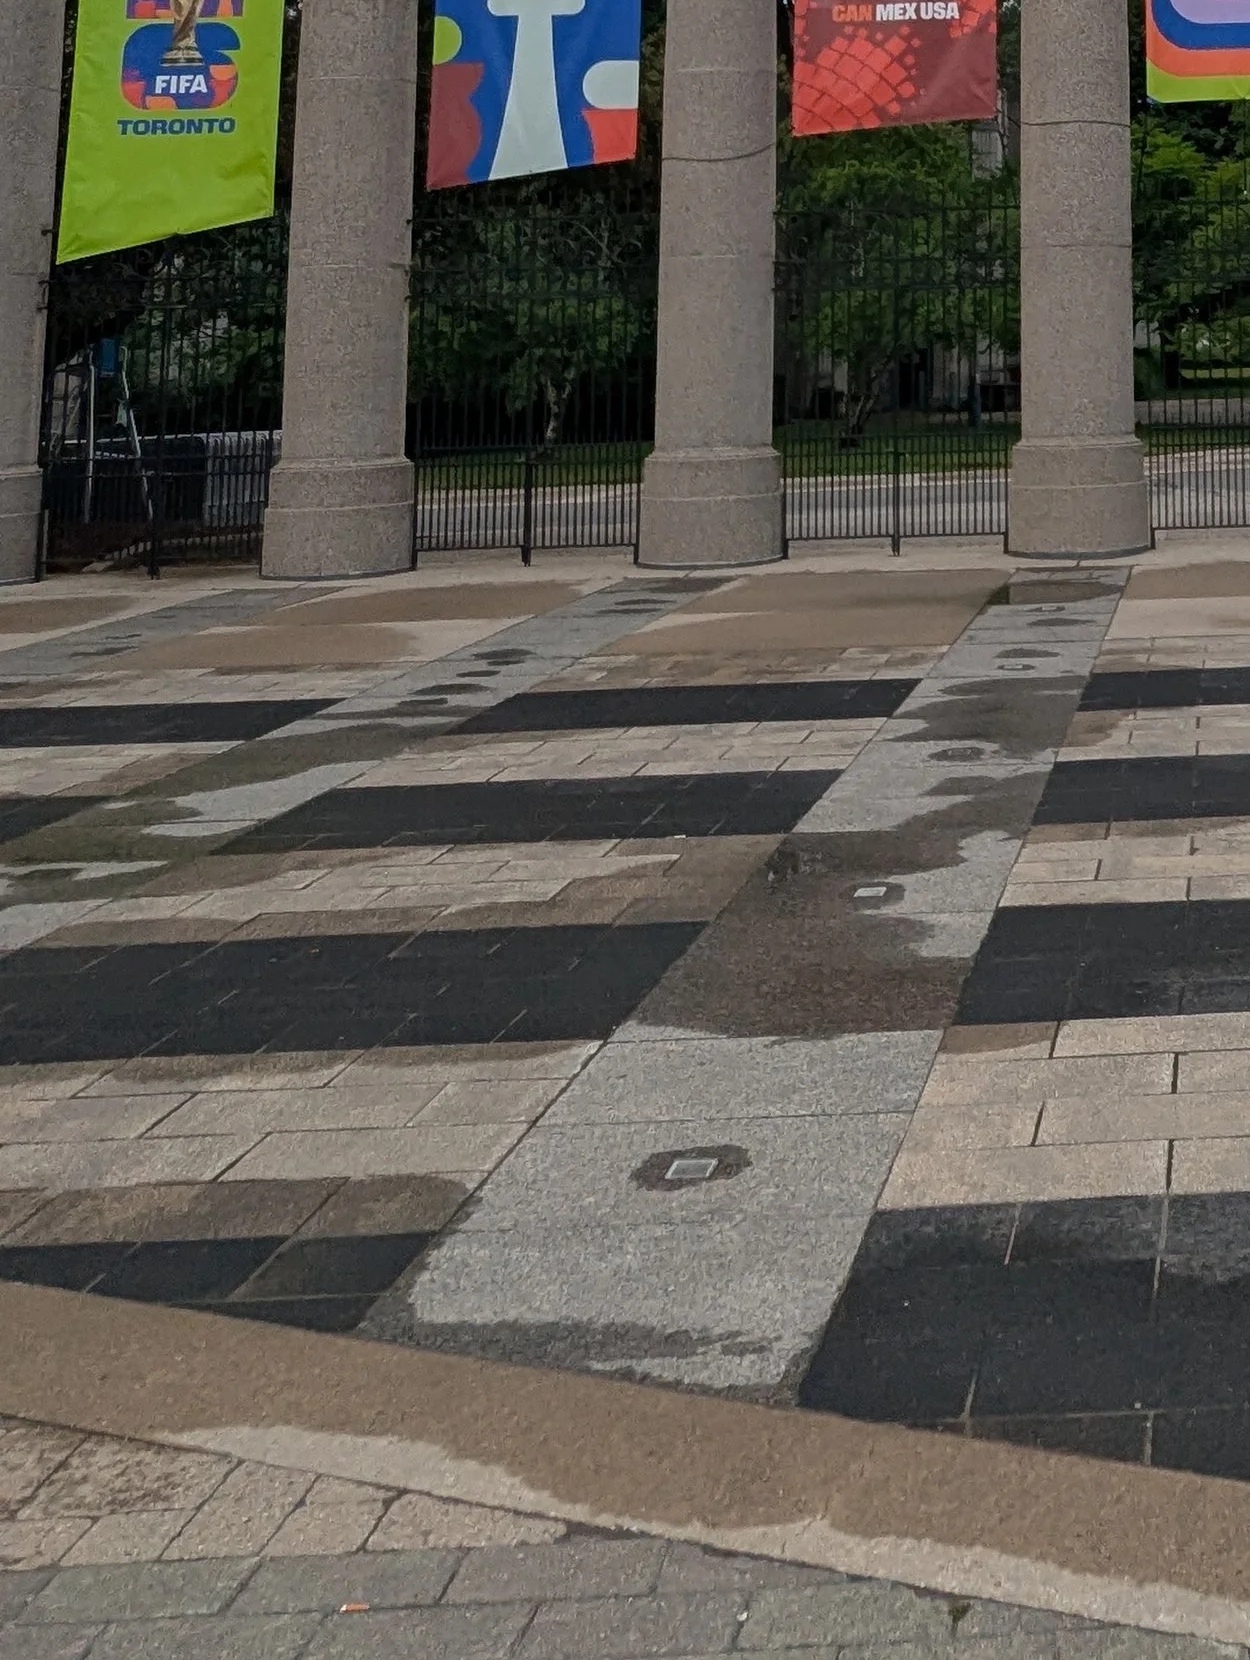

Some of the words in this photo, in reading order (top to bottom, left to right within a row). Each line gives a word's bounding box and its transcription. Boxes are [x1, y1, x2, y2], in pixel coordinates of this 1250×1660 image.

[832, 4, 872, 22] CAN
[876, 2, 918, 22] MEX
[920, 1, 960, 20] USA
[154, 74, 208, 94] FIFA
[117, 117, 236, 135] TORONTO
